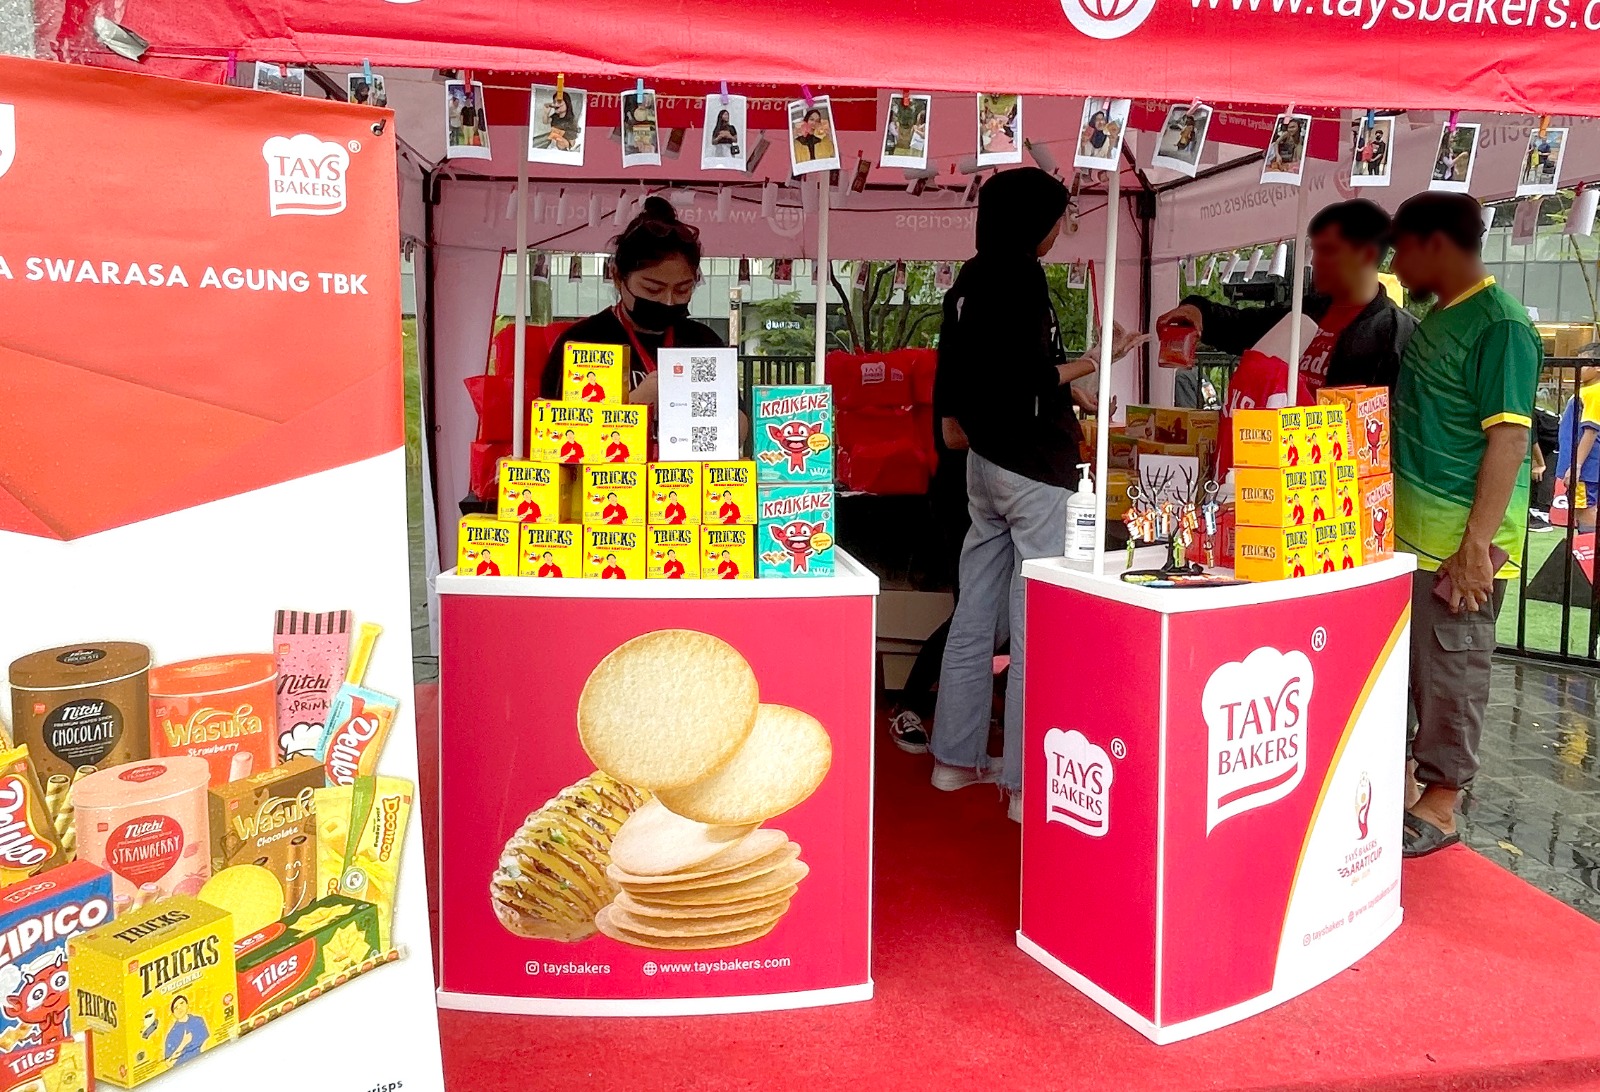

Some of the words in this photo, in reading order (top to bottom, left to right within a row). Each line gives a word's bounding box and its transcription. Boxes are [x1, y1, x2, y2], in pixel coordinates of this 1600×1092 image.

[274, 154, 340, 181] TAYS
[274, 180, 341, 199] BAKERS
[25, 257, 189, 288] SWARASA
[200, 266, 310, 293] AGUNG
[318, 272, 369, 295] TBK
[572, 349, 615, 366] TRICKS
[761, 393, 829, 417] KRAKENZ
[550, 407, 594, 424] TRICKS
[602, 409, 639, 425] RICKS
[1239, 429, 1272, 441] TRICKS
[507, 466, 551, 484] TRICKS
[591, 470, 638, 487] TRICKS
[655, 468, 694, 485] TRICKS
[709, 467, 749, 485] TRICKS
[1241, 487, 1274, 501] TRICKS
[763, 492, 831, 517] KRAKENZ
[467, 526, 510, 544] TRICKS
[528, 529, 573, 546] TRICKS
[592, 531, 637, 548] TRICKS
[653, 529, 692, 544] TRICKS
[708, 530, 747, 545] TRICKS
[1241, 544, 1276, 558] TRICKS
[276, 673, 332, 696] Nitchi
[62, 702, 104, 721] Nitchi
[1219, 676, 1300, 742] TAYS
[52, 720, 114, 747] CHOCOLATE
[162, 704, 262, 747] Wasuka
[187, 742, 239, 758] Strawberry
[1218, 733, 1299, 776] BAKERS
[1051, 752, 1103, 795] TAYS
[1051, 779, 1103, 816] BAKERS
[124, 818, 165, 839] Nitchi
[256, 826, 299, 848] Chocolate
[112, 835, 180, 864] STRAWBERRY
[113, 910, 190, 944] TRICKS
[139, 934, 220, 999] TRICKS
[252, 955, 298, 993] Tiles
[543, 962, 611, 976] taysbakers
[660, 956, 791, 974] www.taysbakers.com
[76, 988, 119, 1028] TRICKS
[8, 1048, 55, 1075] Tiles
